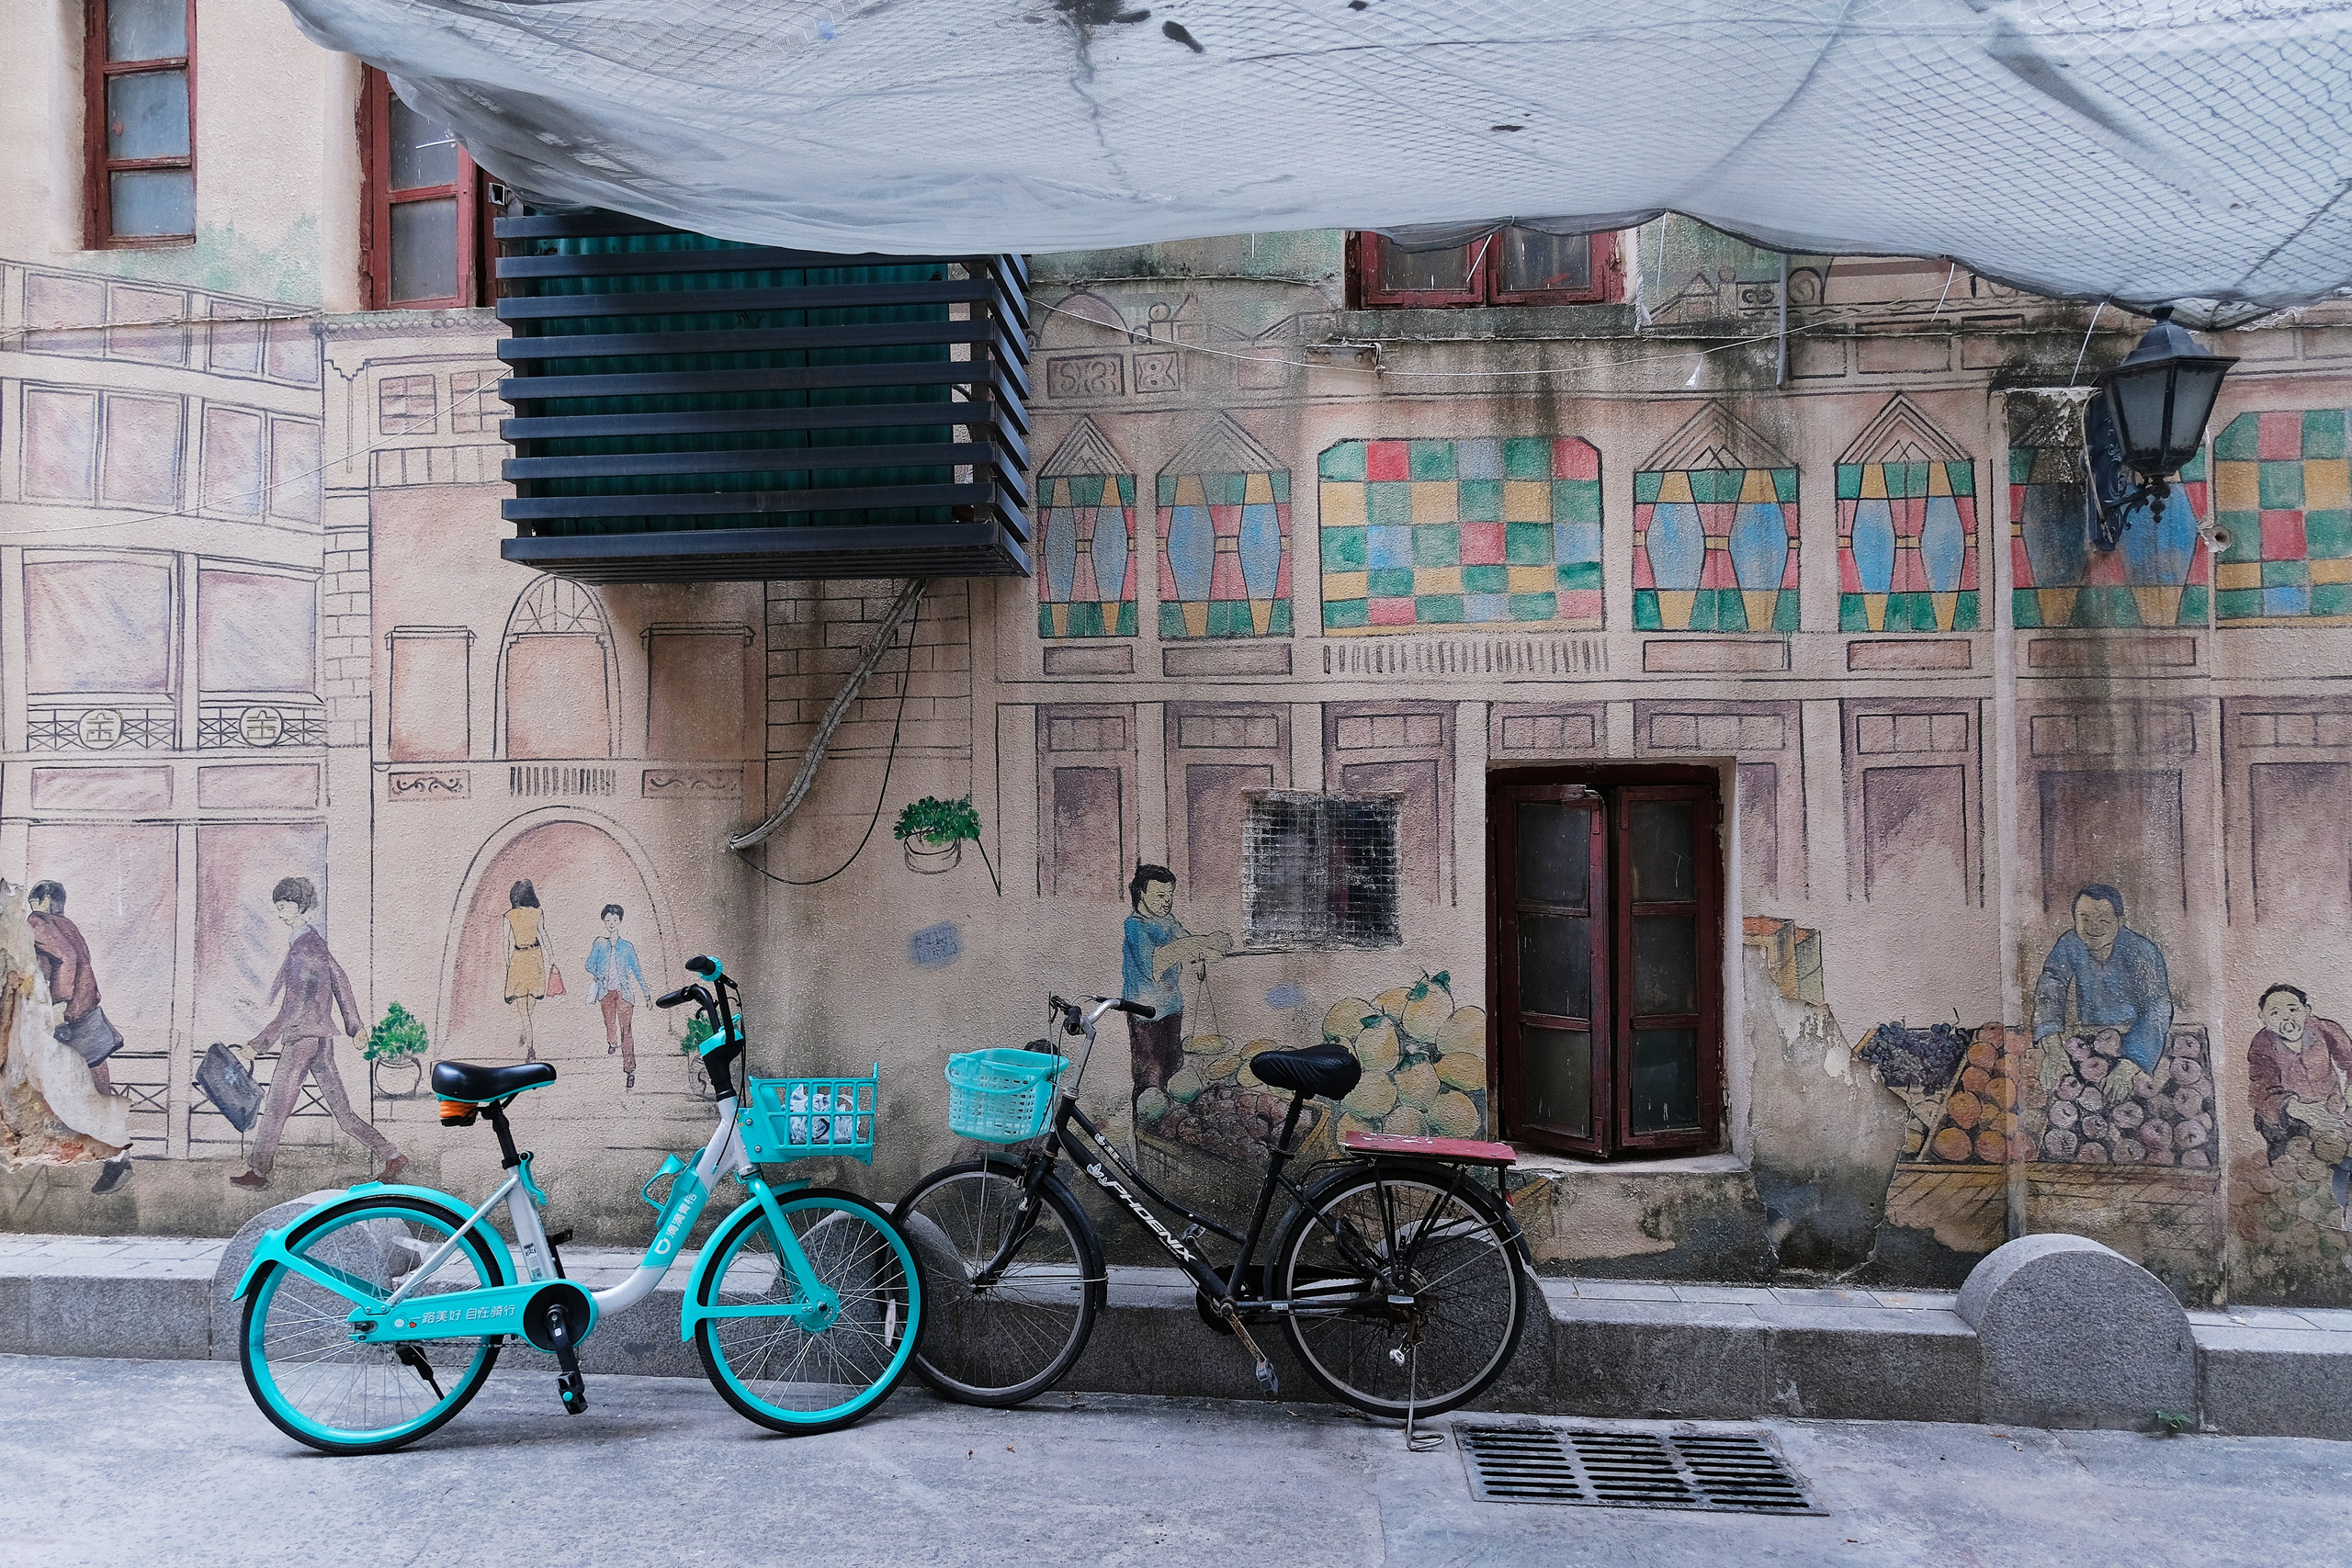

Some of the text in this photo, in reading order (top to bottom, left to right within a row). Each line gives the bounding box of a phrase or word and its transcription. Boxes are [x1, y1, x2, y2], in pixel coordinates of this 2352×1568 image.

[665, 1193, 697, 1238] 滴滴青桔
[1103, 1180, 1197, 1262] PHOENIX
[411, 1304, 516, 1324] 一路美好 自在骑行
